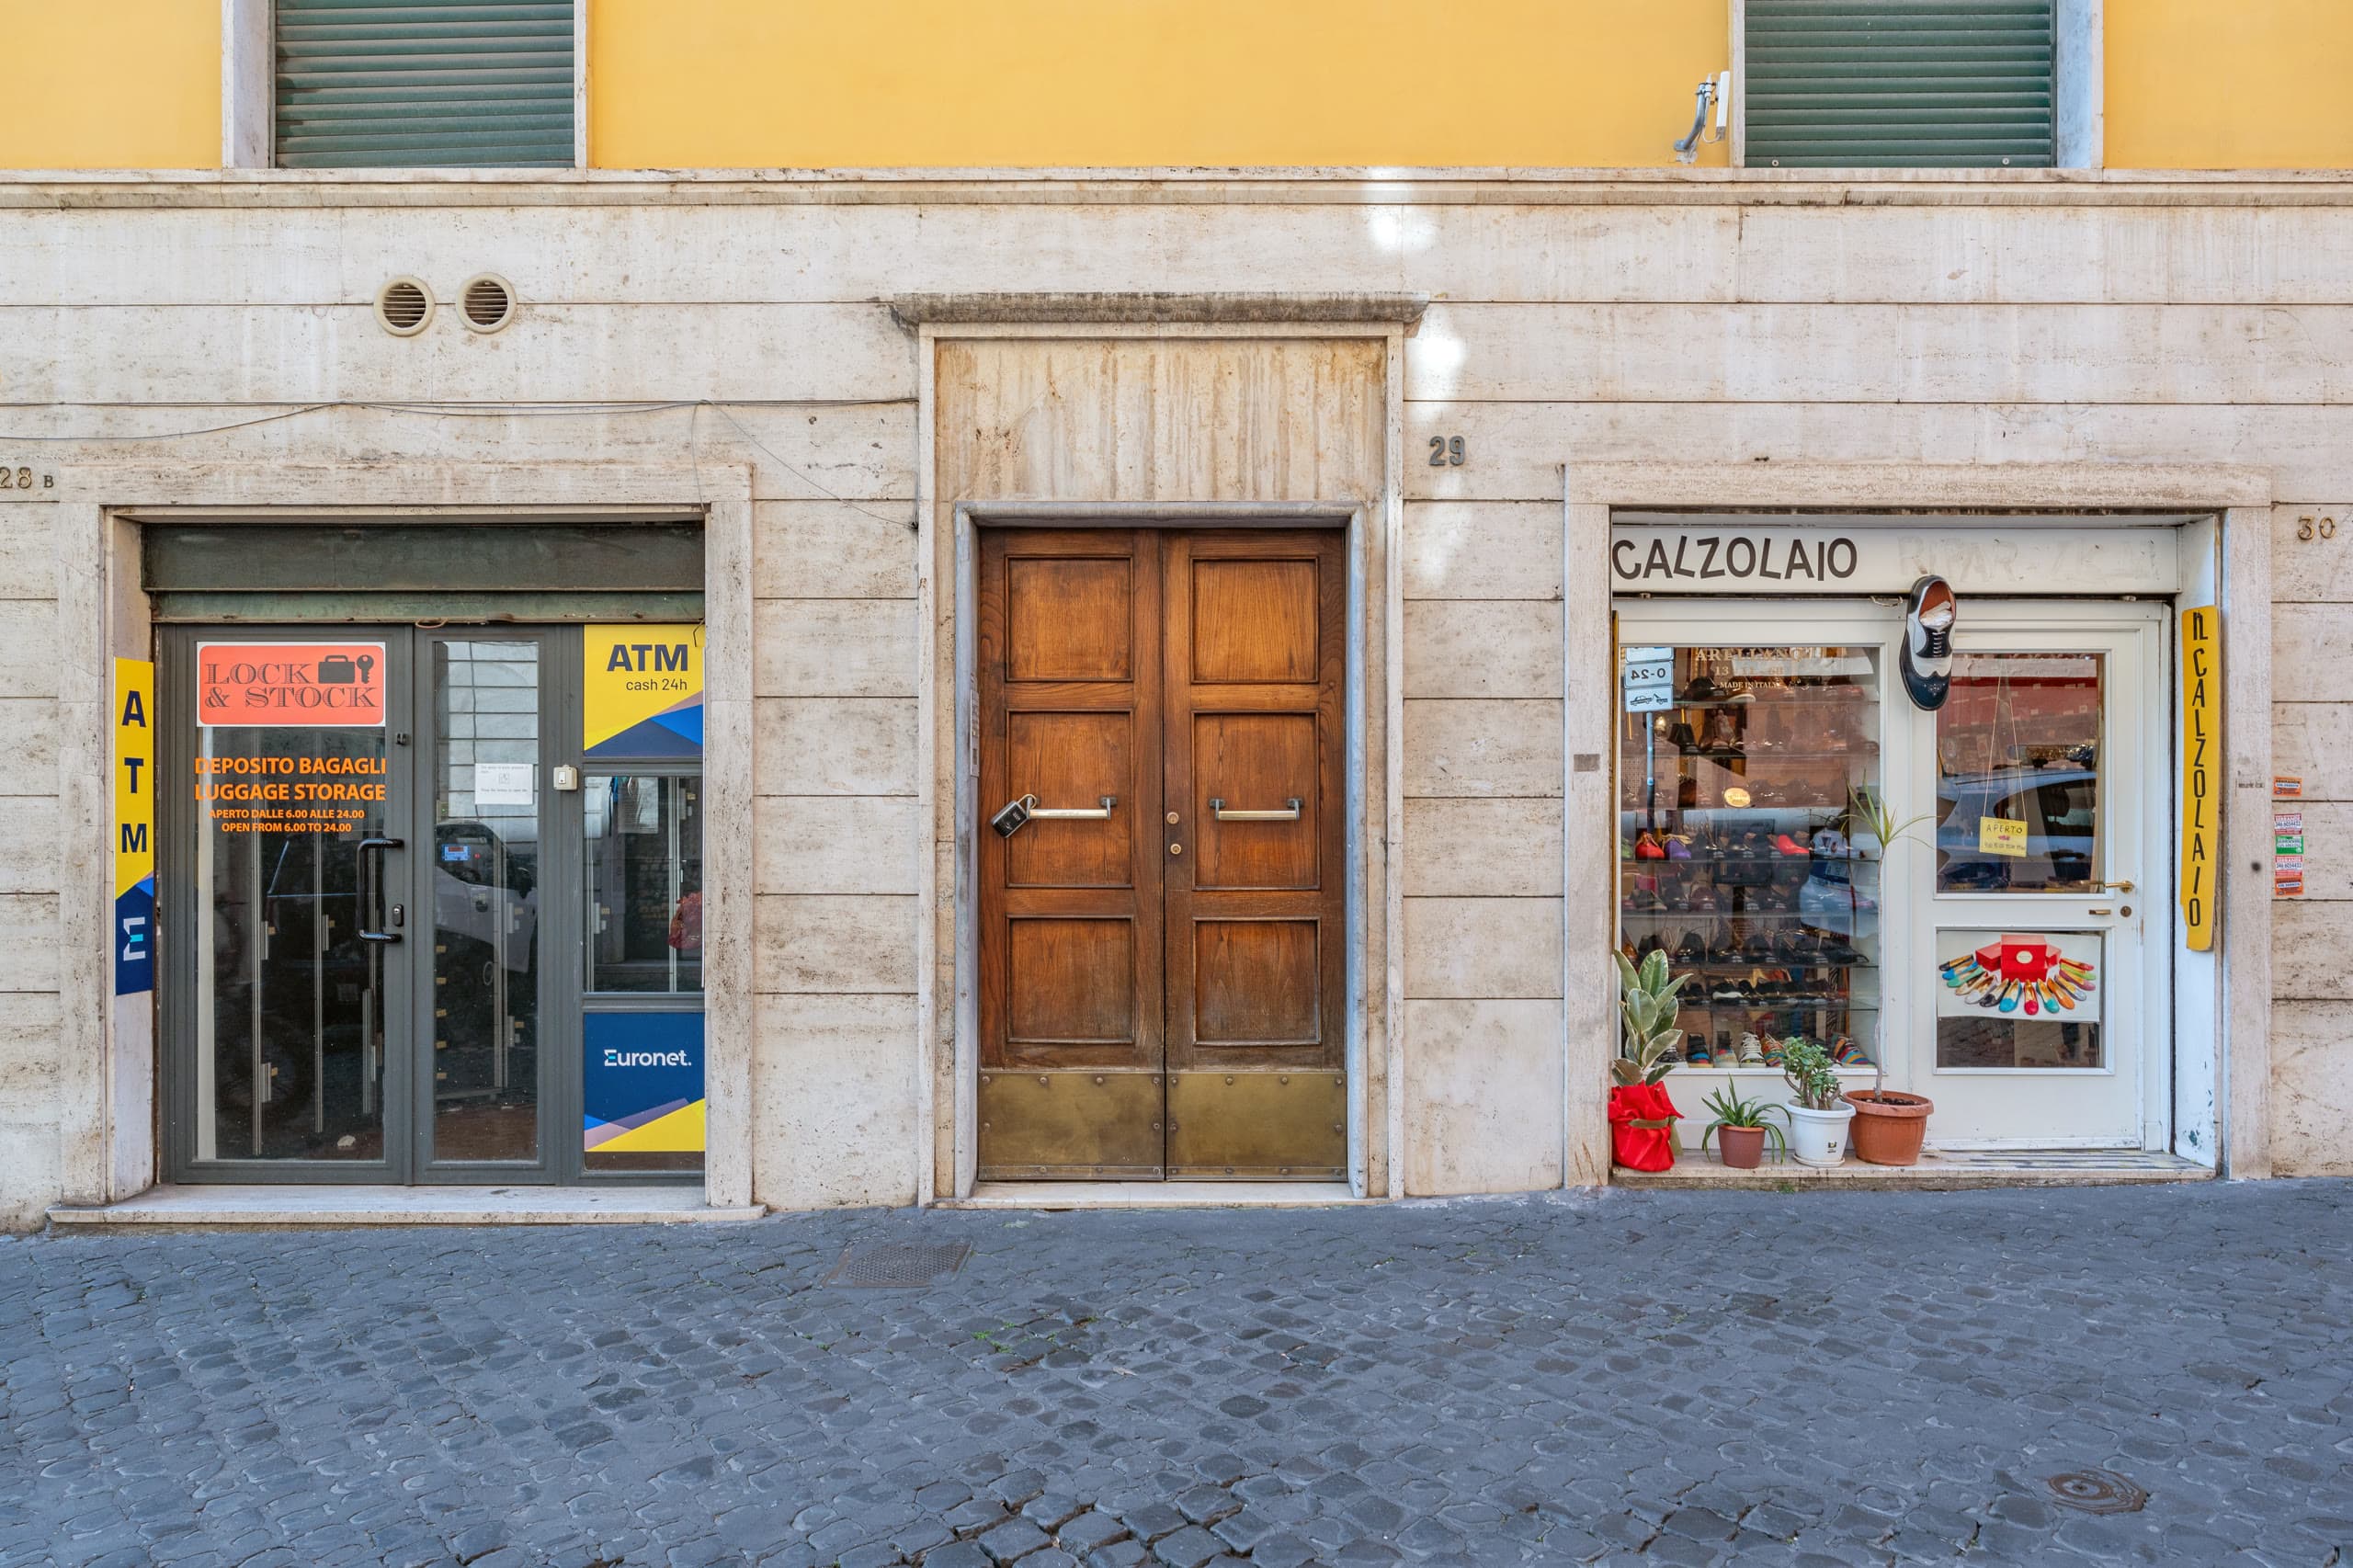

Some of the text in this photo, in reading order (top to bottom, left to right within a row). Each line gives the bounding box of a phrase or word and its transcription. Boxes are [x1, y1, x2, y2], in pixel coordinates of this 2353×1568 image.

[1429, 436, 1465, 466] 29
[0, 466, 54, 489] 28 B
[2298, 517, 2336, 540] 30
[1612, 535, 1858, 581] CALZOLAIO
[607, 644, 688, 672] ATM
[204, 663, 313, 684] LOCK
[626, 678, 688, 691] cash 24h
[204, 687, 379, 708] & STOCK
[121, 690, 147, 854] ATM
[194, 757, 387, 774] DEPOSITO BAGAGLI
[2188, 612, 2208, 927] IL CALZOLAIO
[194, 784, 386, 801] LUGGAGE STORAGE
[209, 809, 365, 818] APERTO DALLE 6.00 ALLE 24.00
[222, 823, 352, 832] OPEN FROM 6.00 TO 24.00
[1986, 824, 2023, 834] APERTO
